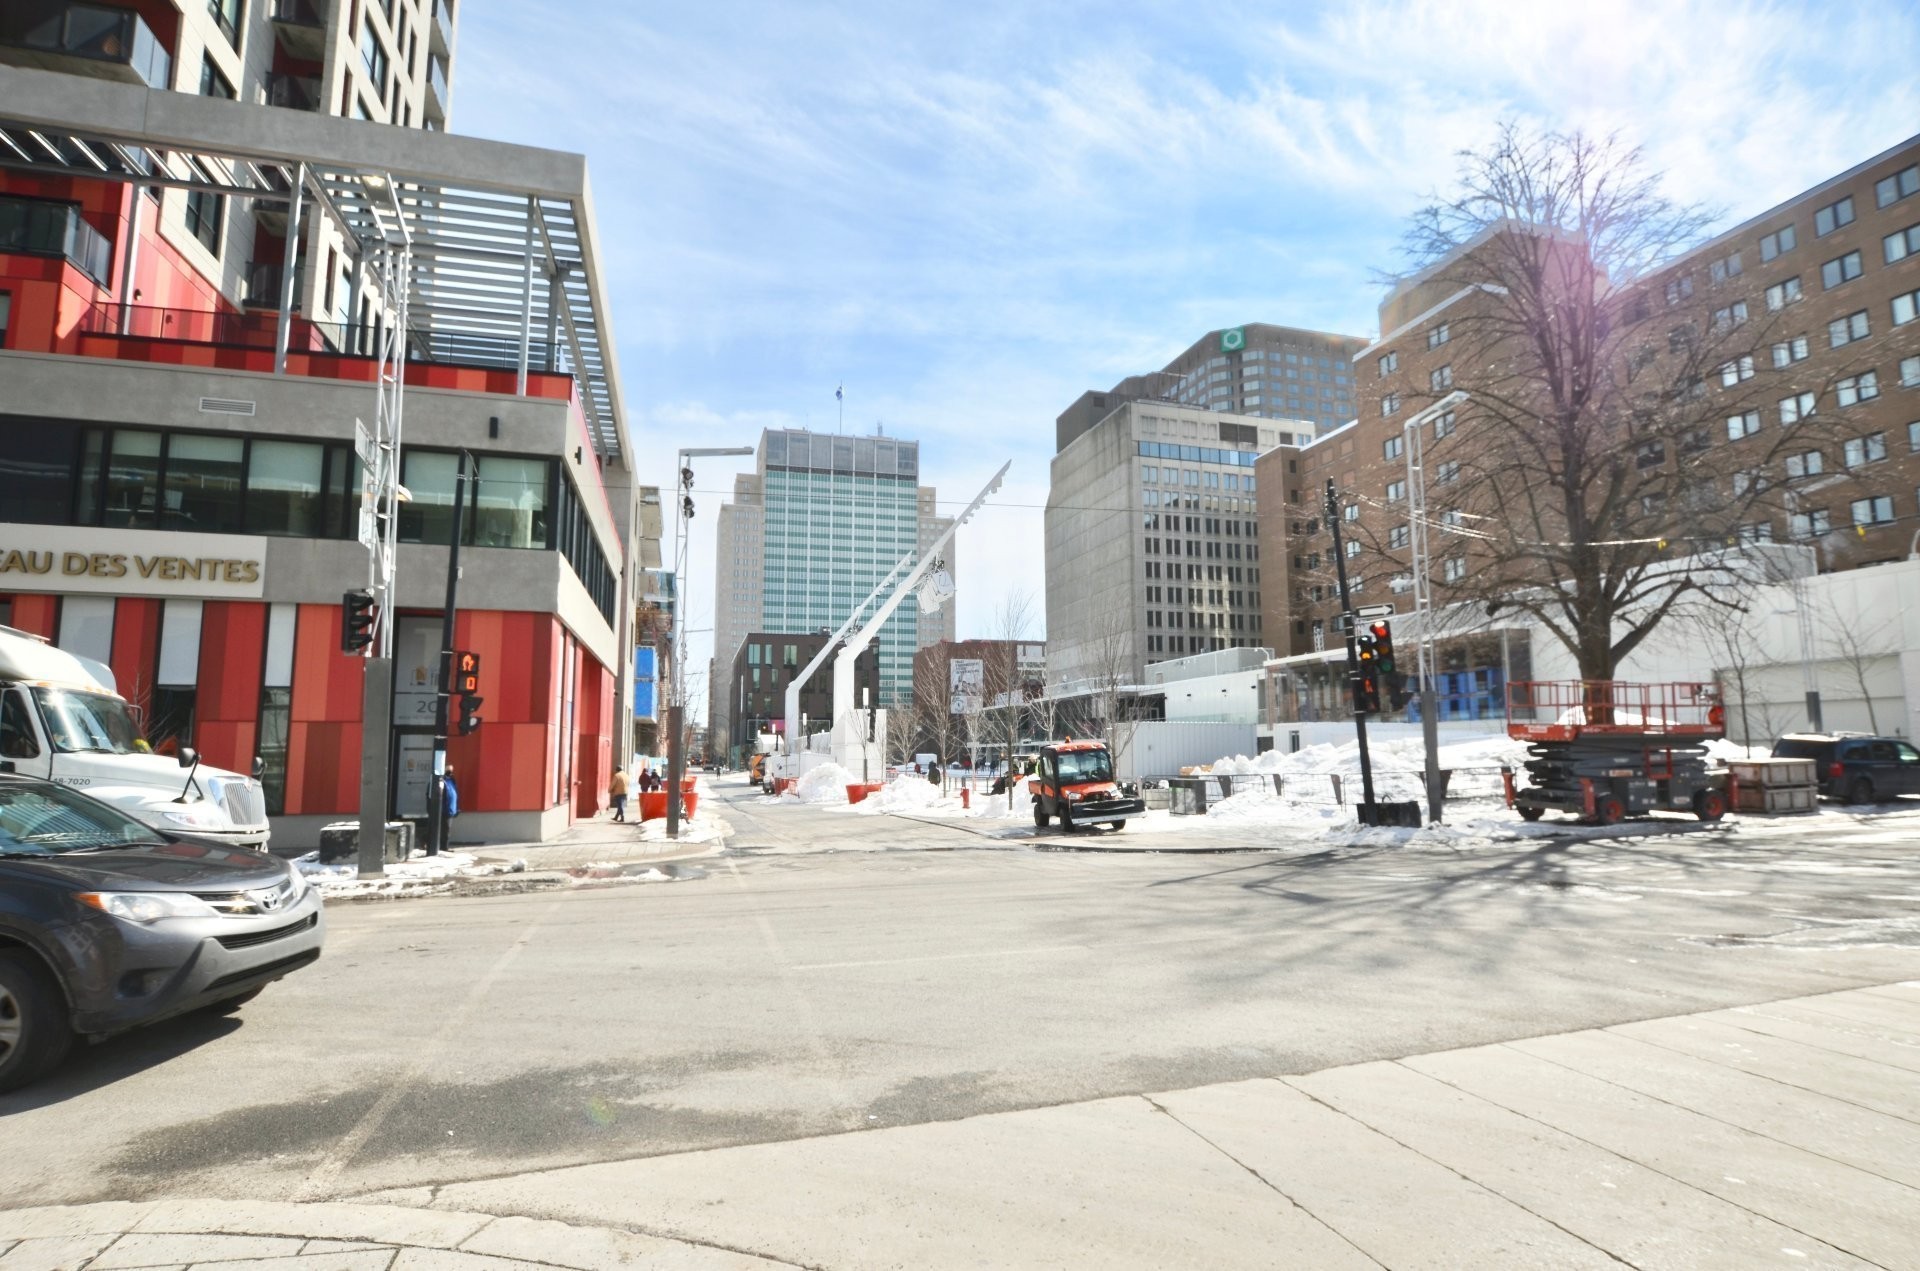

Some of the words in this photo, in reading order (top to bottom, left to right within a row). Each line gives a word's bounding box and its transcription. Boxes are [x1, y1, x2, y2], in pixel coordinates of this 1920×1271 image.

[0, 549, 54, 575] AU
[62, 552, 128, 578] DES
[133, 555, 260, 583] VENTES
